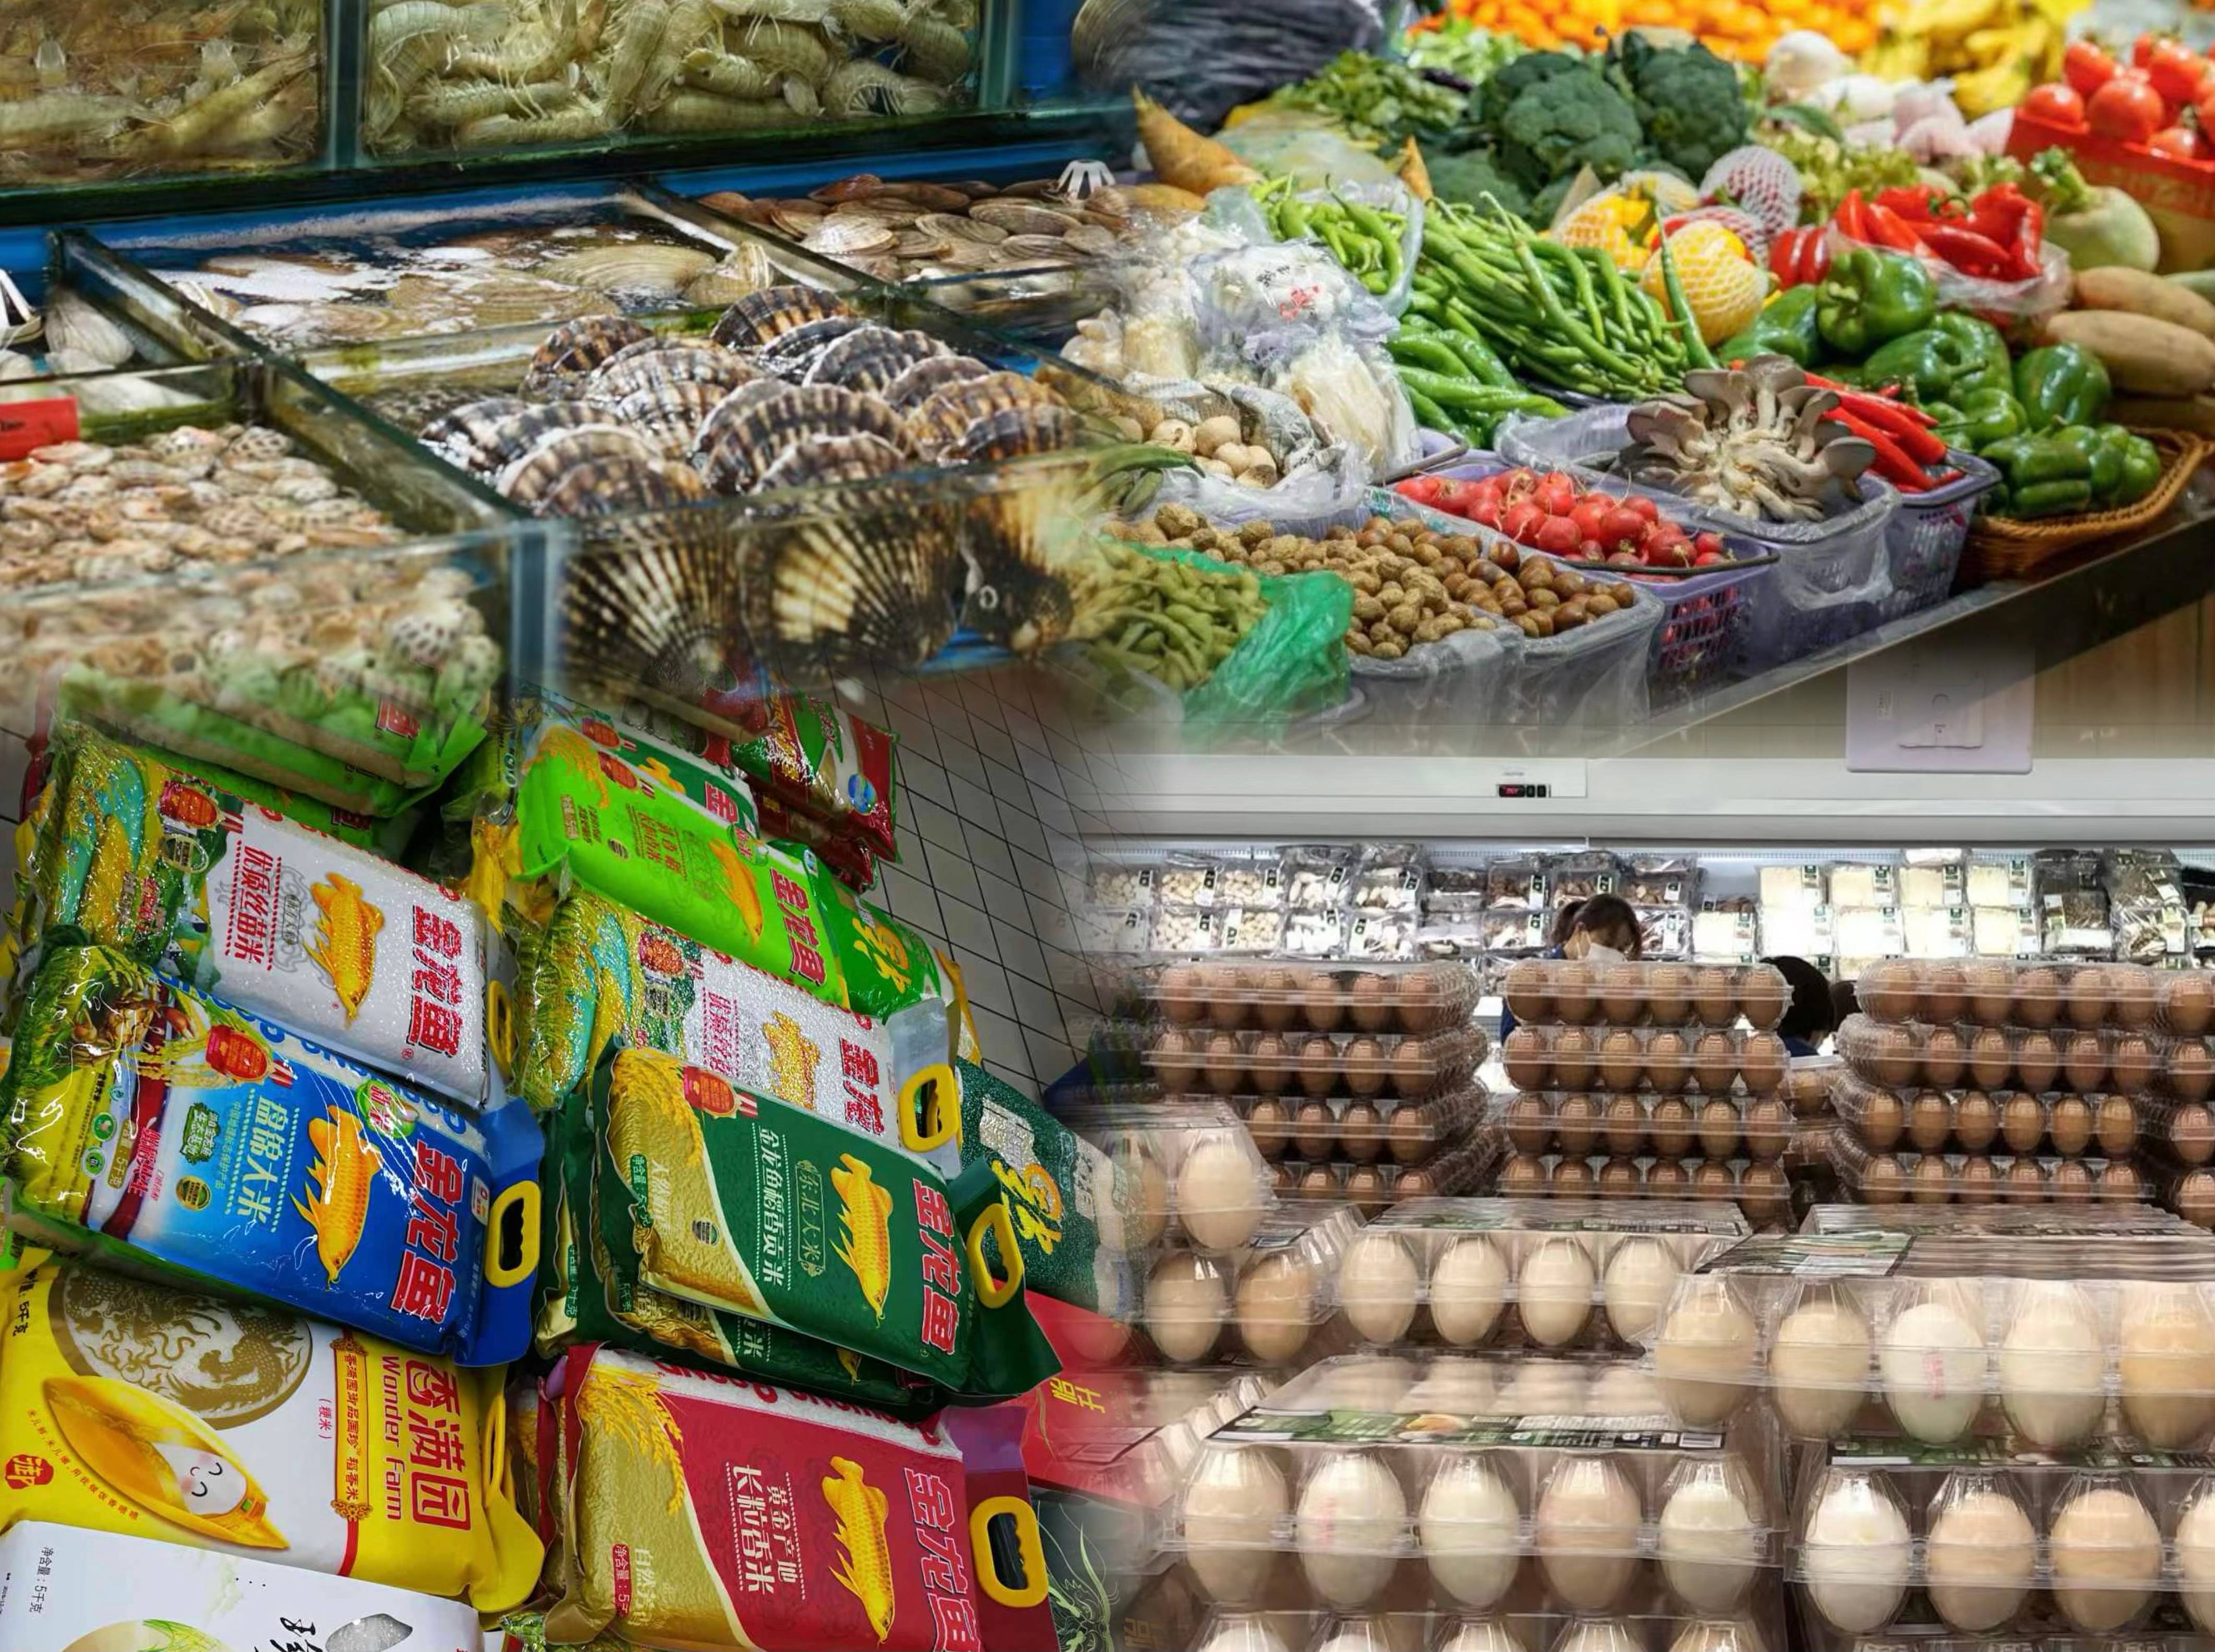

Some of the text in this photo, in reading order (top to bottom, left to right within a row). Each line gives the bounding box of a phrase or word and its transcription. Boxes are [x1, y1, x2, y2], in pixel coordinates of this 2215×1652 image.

[234, 846, 274, 963] 优质丝苗米
[770, 868, 828, 986] 金龙鱼
[406, 904, 464, 1058] 金龙鱼
[840, 1038, 884, 1135] 金龙
[237, 1095, 288, 1224] 盘锦大米
[758, 1126, 786, 1286] 金龙鱼稻香贡米
[798, 1174, 821, 1262] 东北大米
[390, 1138, 465, 1322] 金龙鱼
[913, 1178, 961, 1356] 金龙鱼
[381, 1356, 405, 1520] Wonder Farm
[406, 1360, 471, 1531] 香满园
[30, 1547, 54, 1614] 净含量：5千克
[733, 1465, 775, 1595] 长粒香米
[766, 1485, 798, 1584] 黄金产地
[904, 1468, 981, 1652] 金龙鱼
